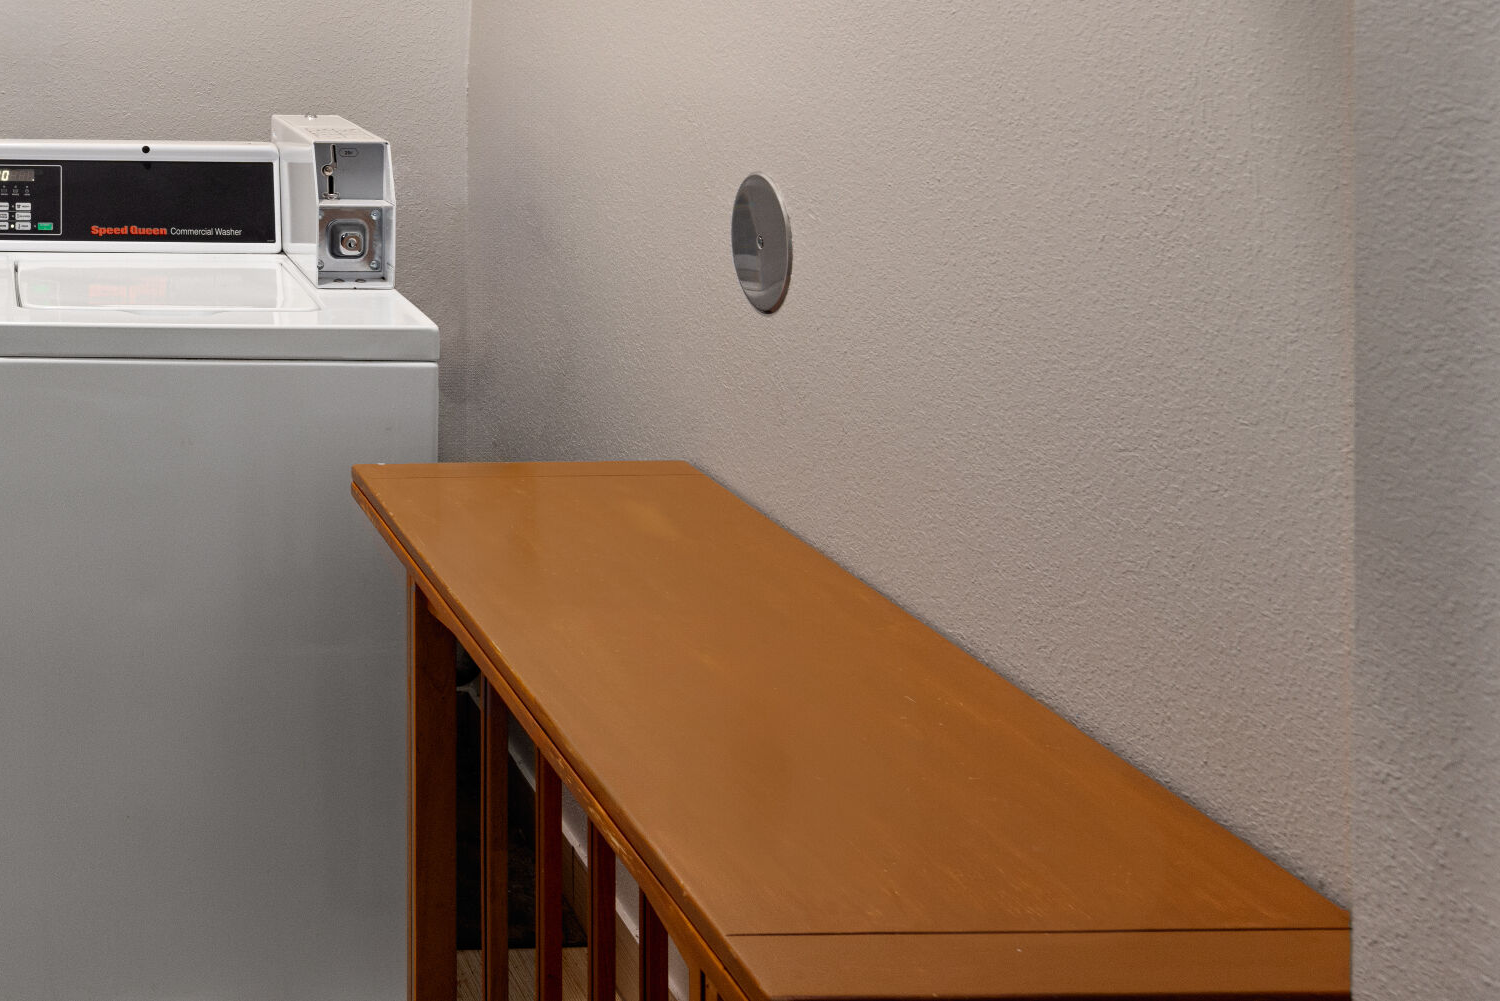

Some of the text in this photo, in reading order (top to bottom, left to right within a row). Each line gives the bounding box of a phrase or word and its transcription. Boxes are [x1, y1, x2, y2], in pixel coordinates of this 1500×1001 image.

[90, 225, 243, 237] Speed Queen Commercial Washer
